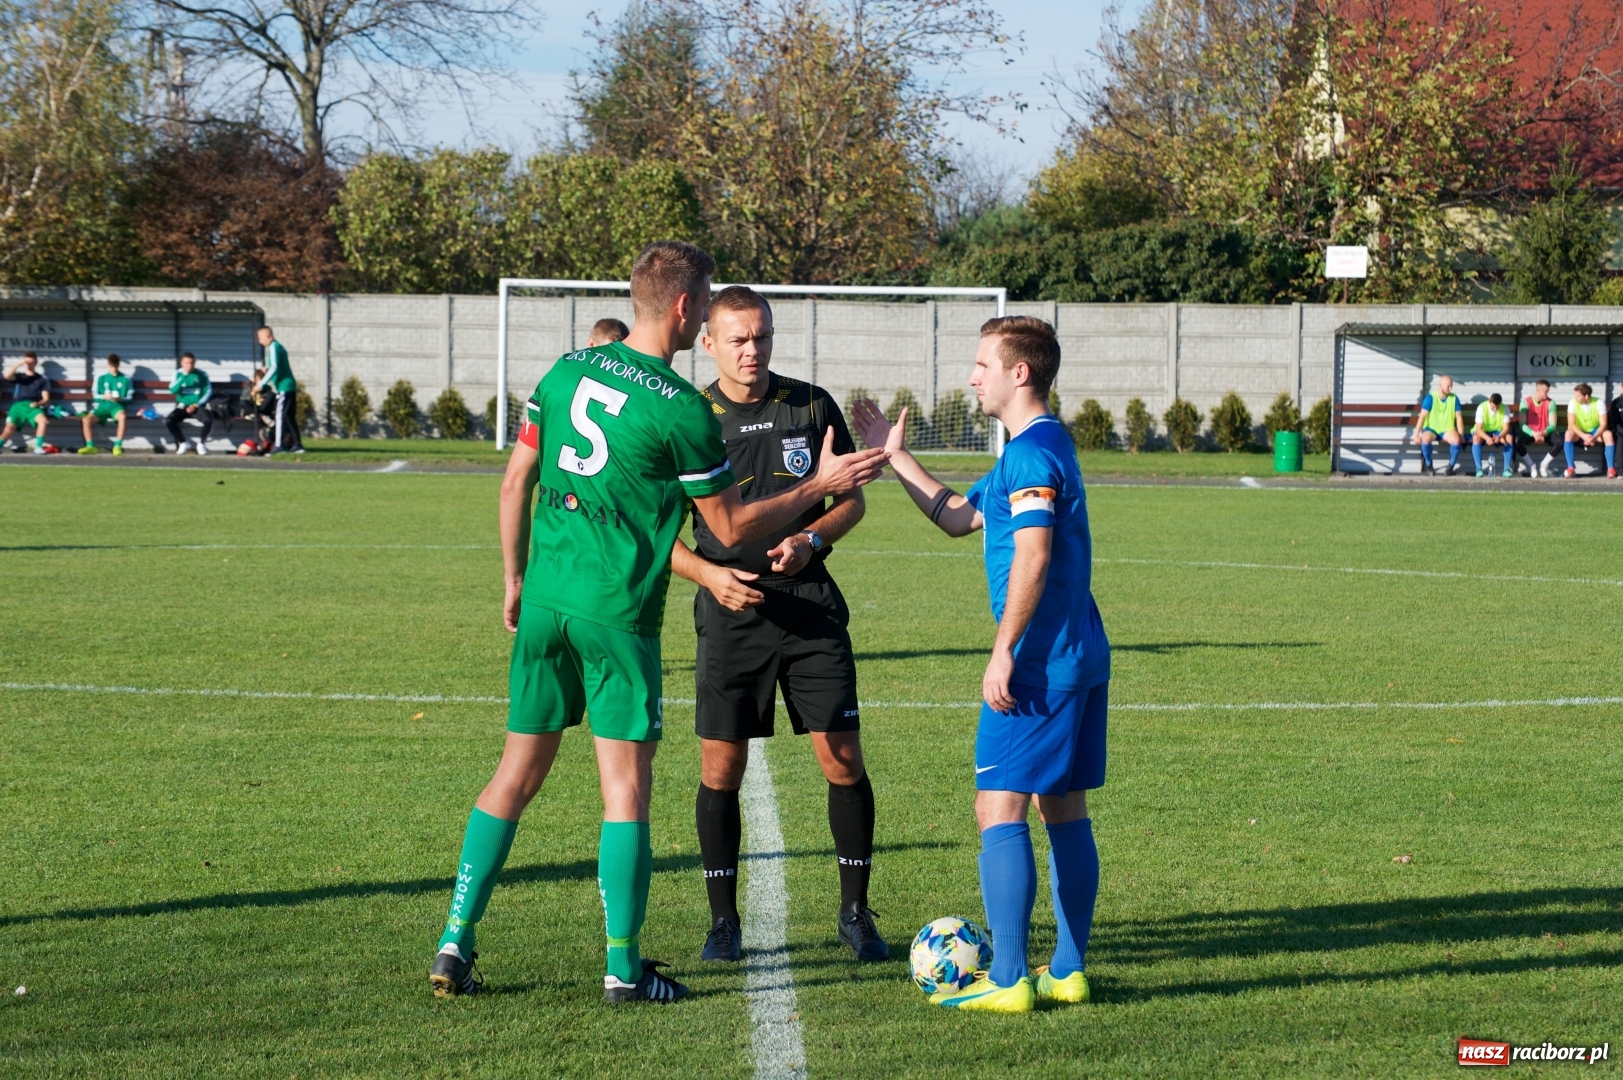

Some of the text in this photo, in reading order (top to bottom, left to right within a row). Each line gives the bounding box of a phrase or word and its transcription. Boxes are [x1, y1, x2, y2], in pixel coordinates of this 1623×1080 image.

[27, 324, 57, 334] LKS
[0, 333, 83, 349] TWORKÓW
[1530, 351, 1596, 368] GOŚCIE
[590, 352, 680, 400] TWORKÓW
[557, 374, 630, 477] 5
